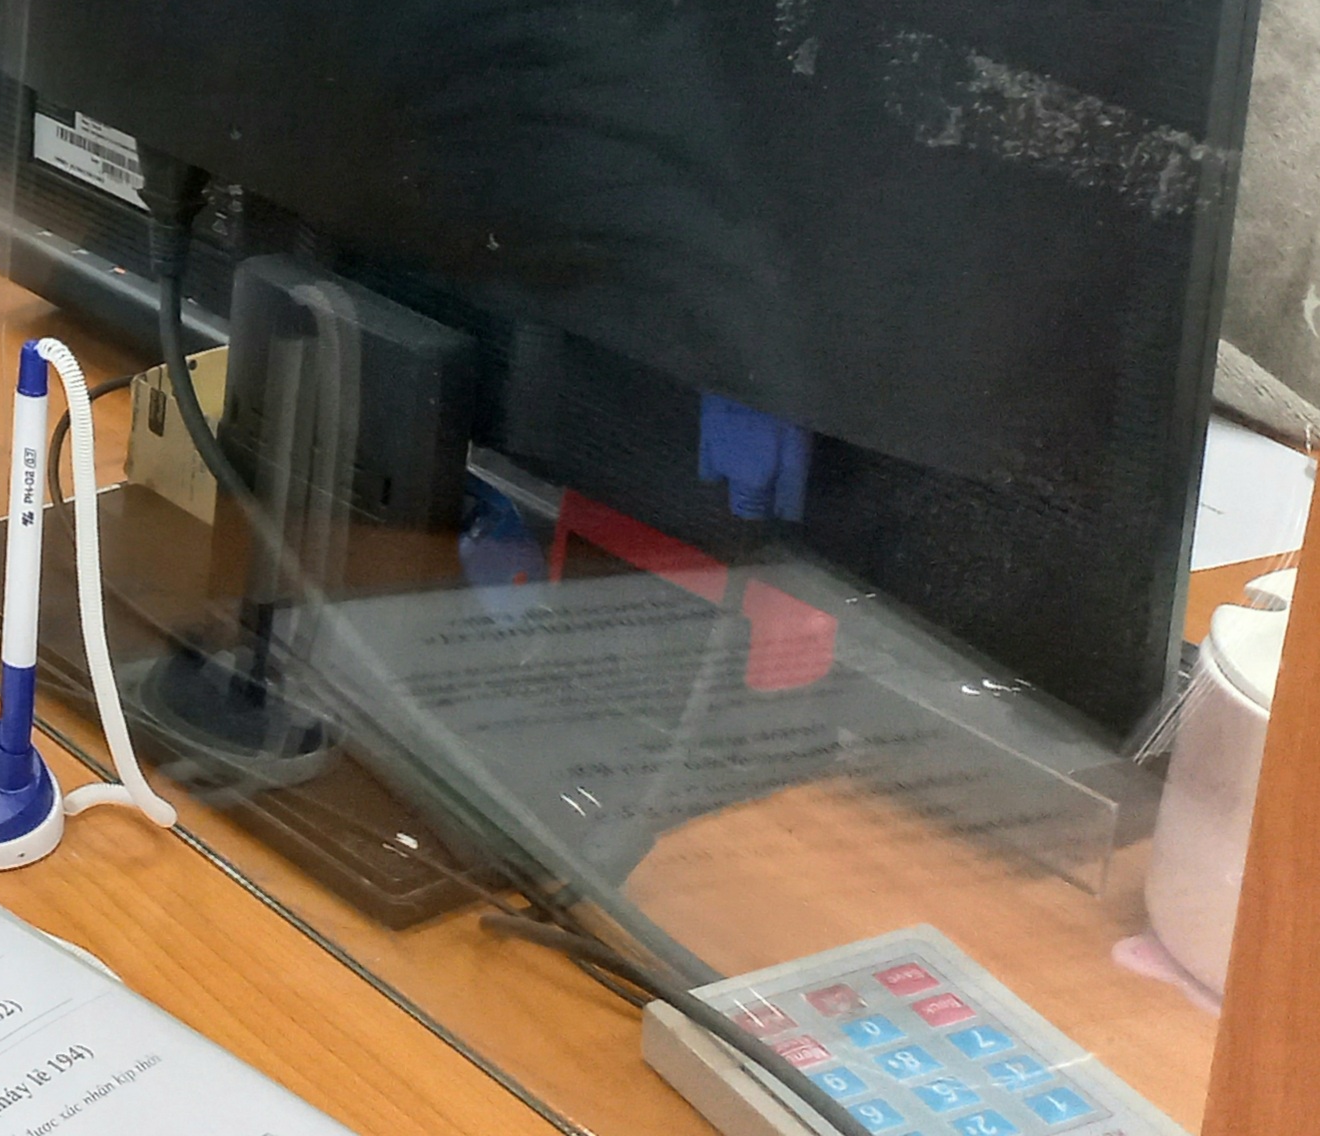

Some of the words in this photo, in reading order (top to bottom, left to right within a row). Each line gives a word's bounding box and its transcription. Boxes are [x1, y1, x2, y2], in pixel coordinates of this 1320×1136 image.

[972, 1030, 995, 1049] 7
[26, 1069, 52, 1086] lẻ
[47, 1045, 94, 1073] 194)
[1045, 1096, 1068, 1115] 1
